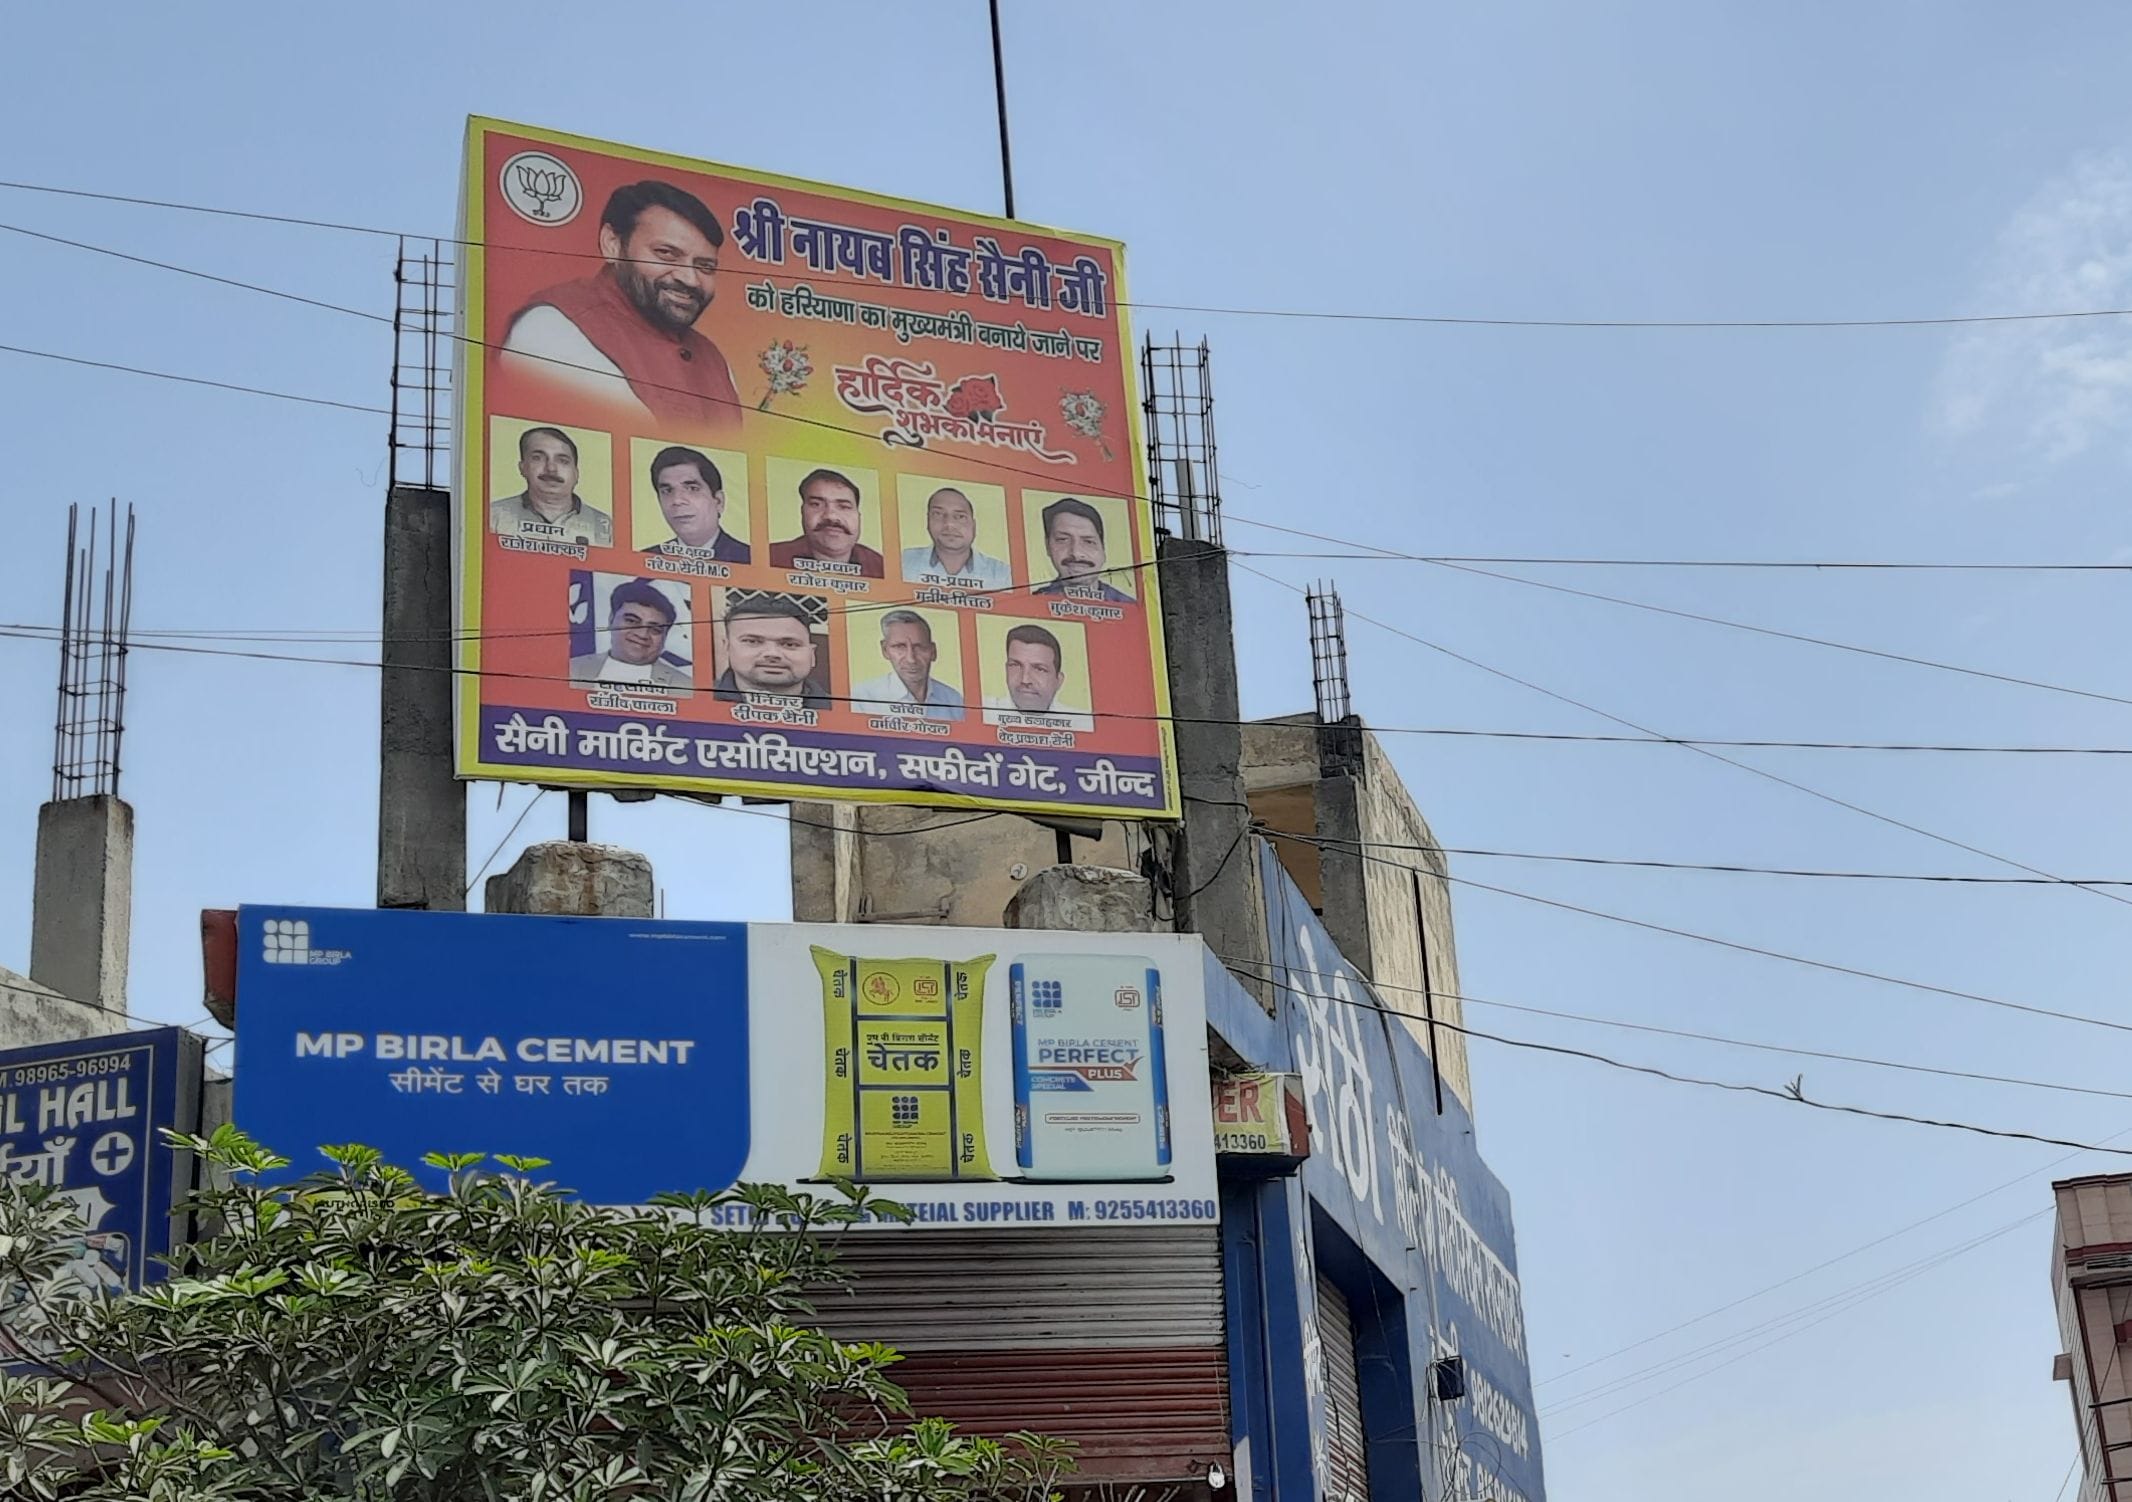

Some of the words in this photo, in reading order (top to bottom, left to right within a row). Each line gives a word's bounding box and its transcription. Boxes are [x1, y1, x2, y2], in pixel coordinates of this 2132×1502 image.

[733, 199, 784, 262] श्री
[791, 221, 895, 282] नायब
[899, 226, 971, 293] सिंह
[976, 238, 1050, 308] सैनी
[1056, 257, 1106, 315] जी
[747, 282, 775, 310] को
[781, 287, 855, 324] हरियाणा
[861, 307, 887, 328] का
[892, 310, 973, 344] मुख्यमंत्री
[1032, 328, 1072, 358] जाने
[1077, 339, 1101, 362] पर
[835, 357, 943, 414] हार्दिक
[521, 522, 565, 537] प्रधान
[494, 713, 569, 757] सैनी
[578, 723, 690, 766] मार्किट
[695, 733, 887, 780] एसोसिएशन,
[897, 750, 1003, 788] सफीदों
[1009, 759, 1067, 795] गेट,
[1075, 759, 1156, 798] जीन्द
[296, 1032, 364, 1058] MP
[376, 1034, 506, 1061] BIRLA
[516, 1037, 695, 1065] CEMENT
[867, 1044, 940, 1071] चेतक
[1039, 1048, 1139, 1064] PERFECT
[389, 1067, 464, 1094] सीमेंट
[476, 1068, 501, 1095] से
[514, 1074, 551, 1096] घर
[562, 1076, 609, 1096] तक
[1088, 1068, 1122, 1080] PLUS
[38, 1077, 136, 1134] HALL
[963, 1201, 1055, 1222] SUPPLIER
[1068, 1200, 1090, 1221] M:
[1095, 1199, 1217, 1221] 9255413360
